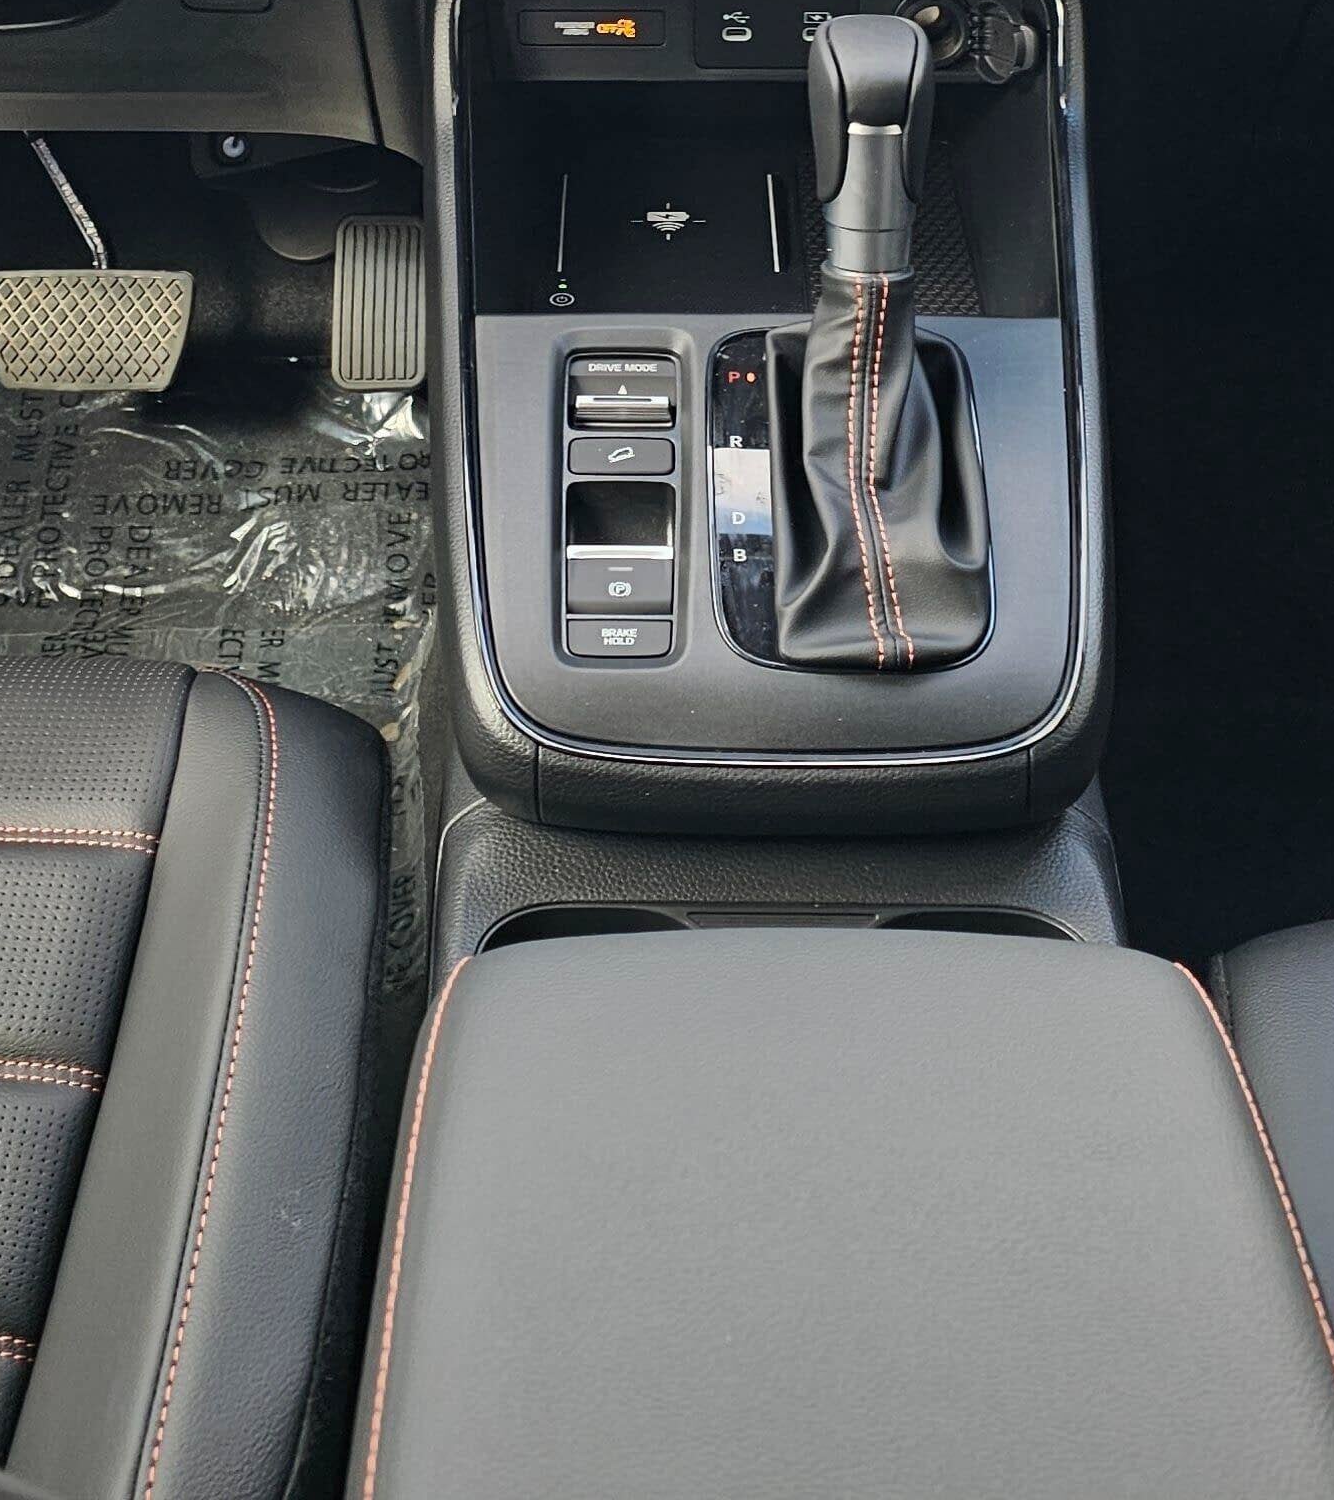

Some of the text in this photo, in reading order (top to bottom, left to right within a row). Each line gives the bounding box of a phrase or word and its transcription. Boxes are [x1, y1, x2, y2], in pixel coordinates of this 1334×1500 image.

[588, 363, 658, 372] DRIVE MODE
[728, 371, 741, 384] P
[12, 394, 46, 462] MUST
[729, 435, 743, 448] R
[280, 450, 432, 475] ROTECTIVE
[32, 422, 80, 579] PROTECTIVE
[93, 481, 429, 517] EALER MUST REMOVE
[731, 511, 745, 525] D
[733, 548, 747, 562] B
[601, 628, 638, 638] BRAKE
[603, 637, 635, 646] HOLD
